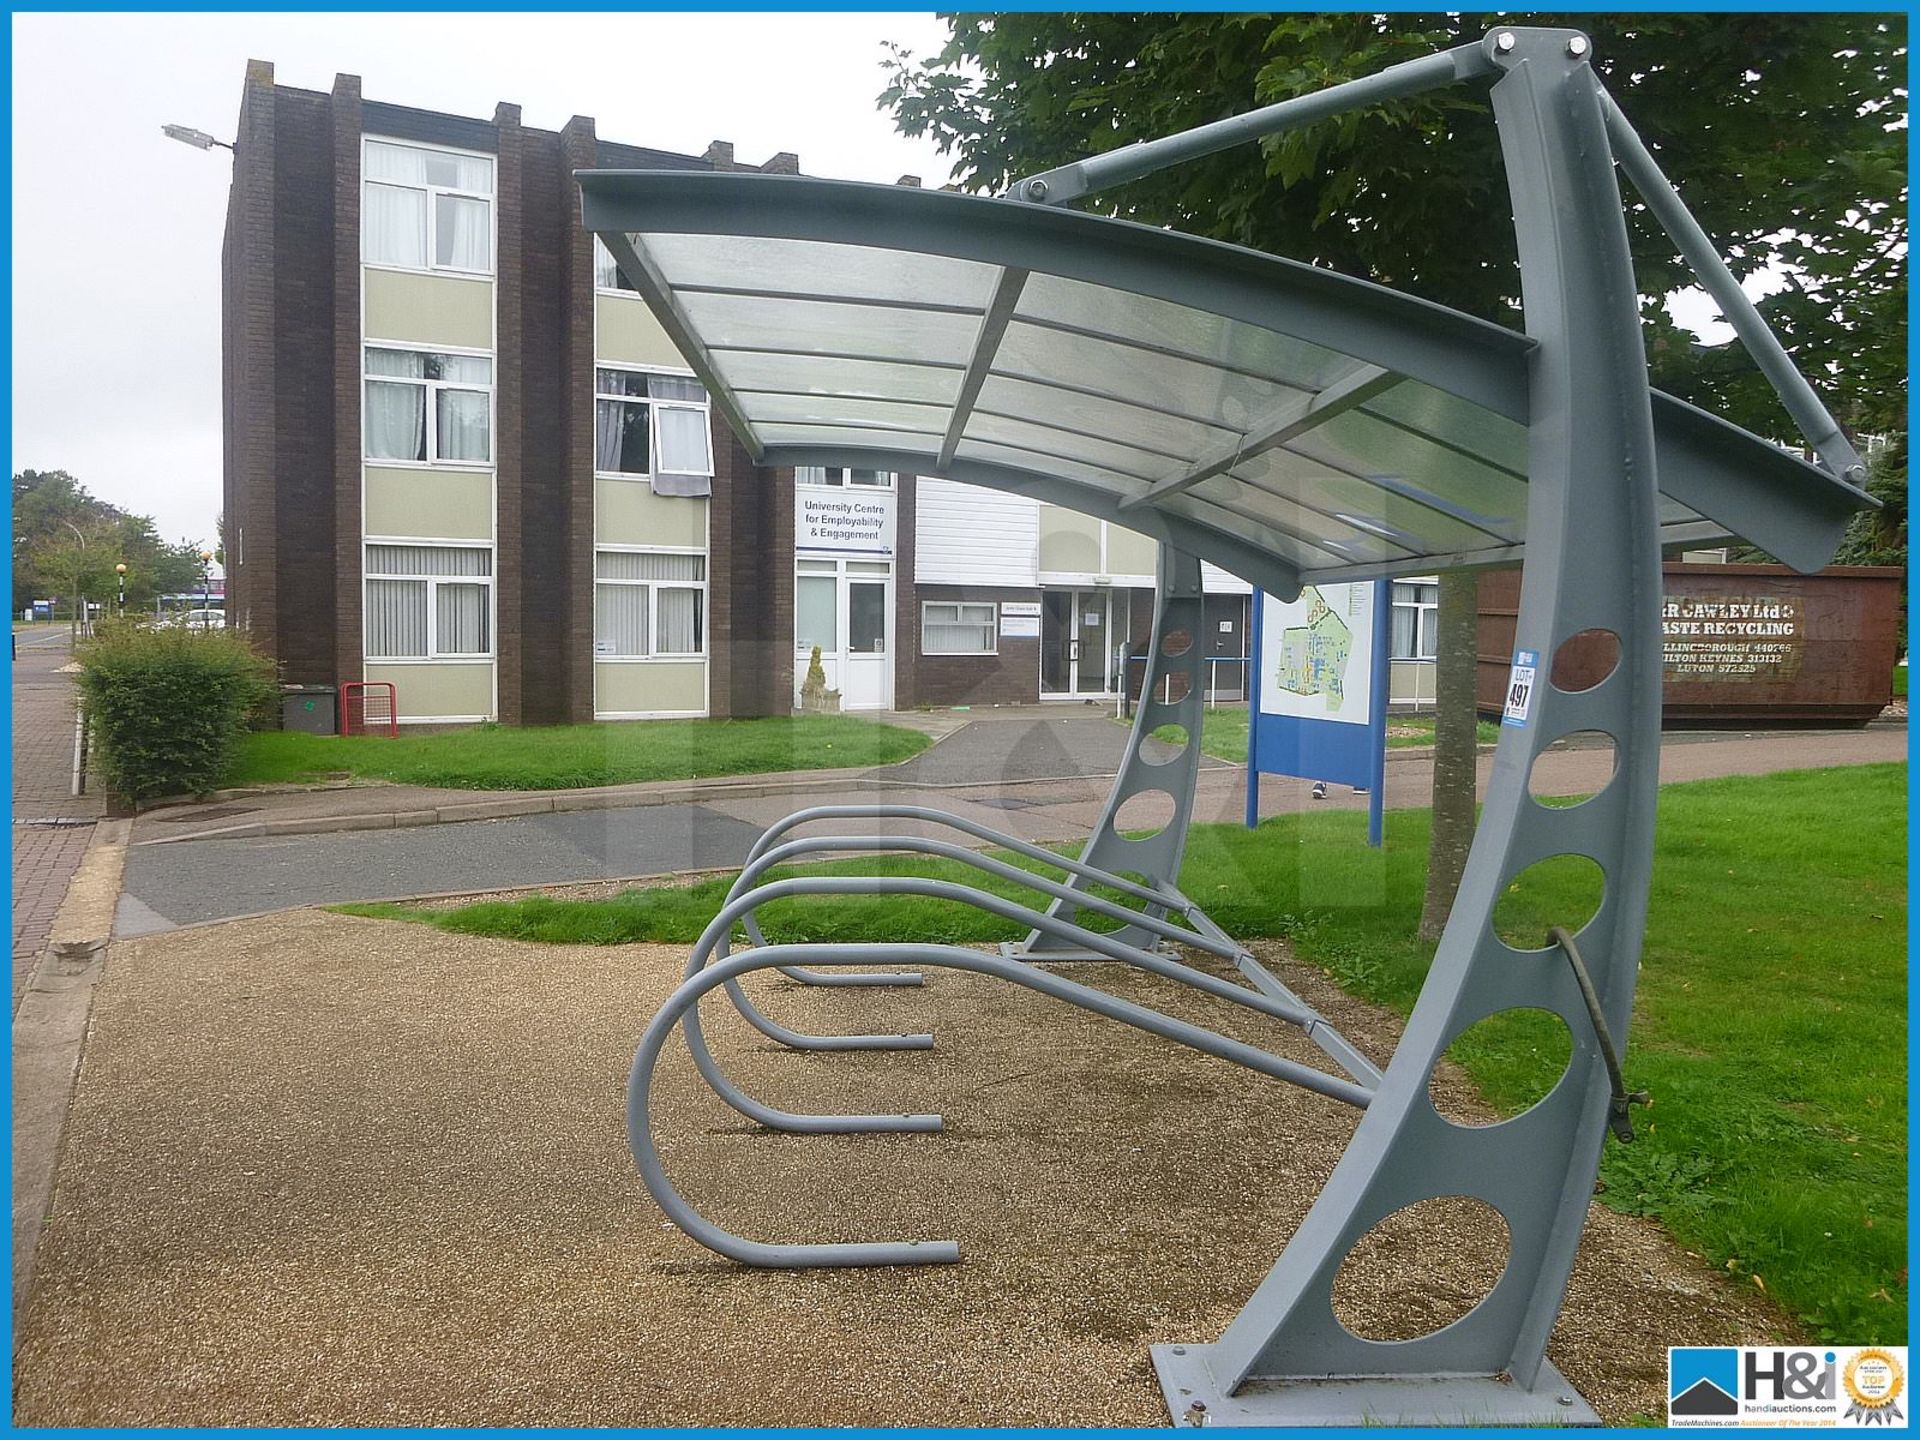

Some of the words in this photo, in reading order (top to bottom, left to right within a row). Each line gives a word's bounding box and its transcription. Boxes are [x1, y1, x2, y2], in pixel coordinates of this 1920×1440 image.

[804, 500, 852, 514] University
[854, 503, 885, 514] Centre
[805, 513, 819, 523] for
[821, 514, 884, 529] Employability
[810, 527, 818, 537] &
[820, 527, 878, 540] Engagement
[1682, 603, 1751, 618] CAWLEY
[1753, 604, 1780, 618] Ltd
[1703, 622, 1795, 636] RECYCLING
[1699, 653, 1743, 663] KEYNES
[1747, 653, 1783, 663] 313132
[1677, 664, 1714, 673] LUTON
[1509, 683, 1530, 708] 497
